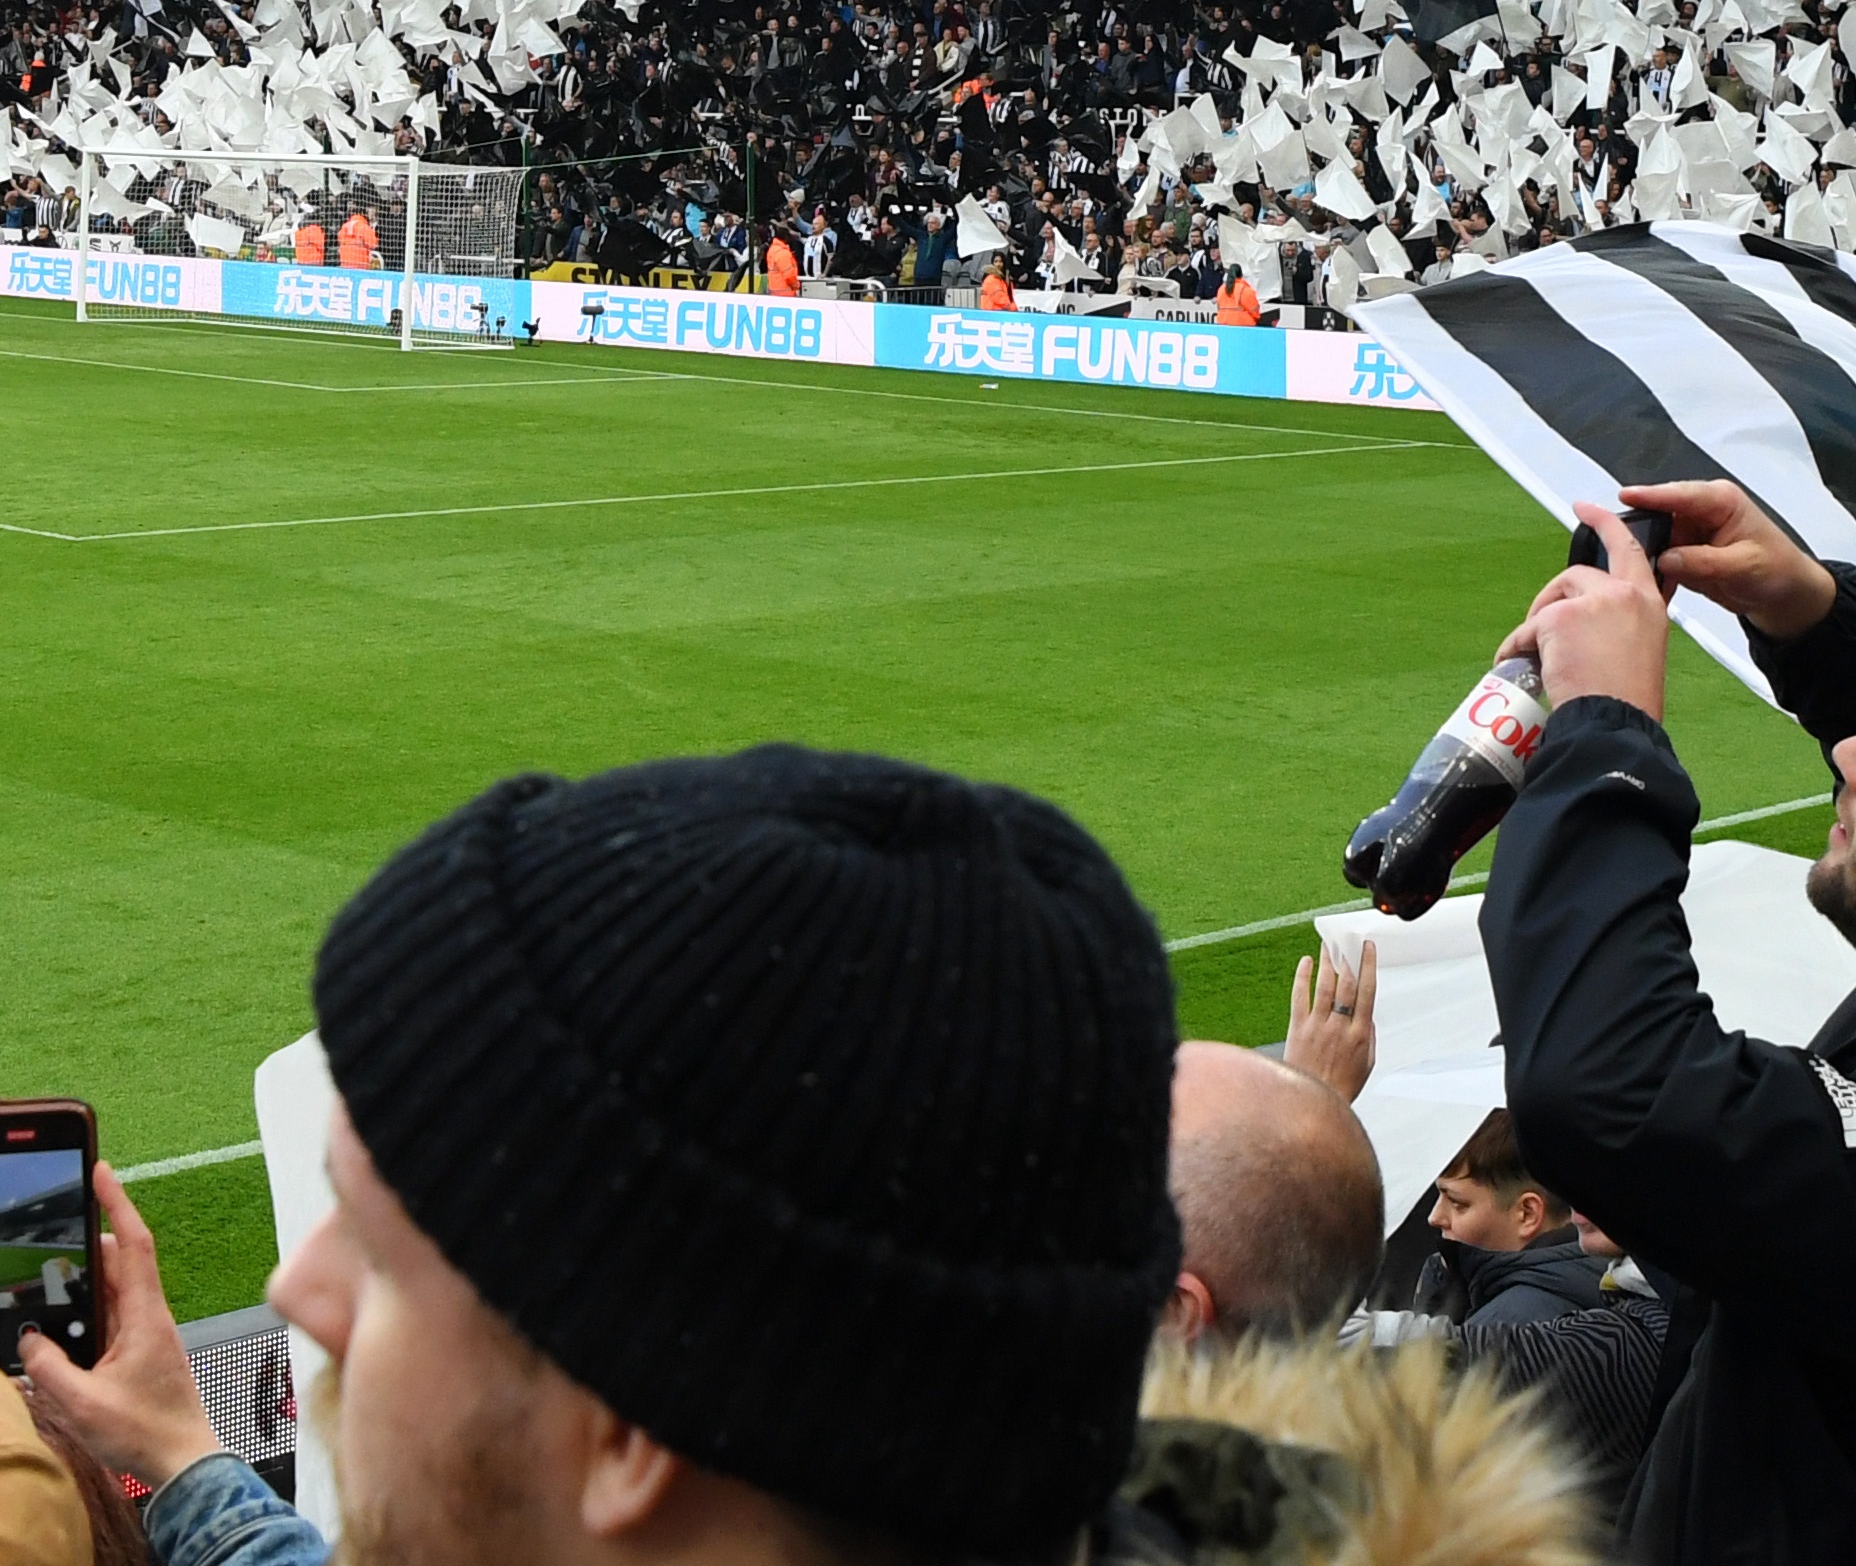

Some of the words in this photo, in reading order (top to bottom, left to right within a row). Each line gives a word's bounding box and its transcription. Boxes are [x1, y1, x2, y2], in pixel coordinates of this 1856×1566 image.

[7, 250, 72, 296] 乐天堂
[86, 260, 181, 305] FUN88
[274, 269, 353, 315] 乐天堂
[357, 278, 483, 331] FUN88
[577, 289, 669, 343] 乐天堂
[676, 300, 822, 357] FUN88
[923, 312, 1035, 374] 乐天堂
[1042, 324, 1219, 389] FUN88
[1468, 692, 1542, 767] Cok
